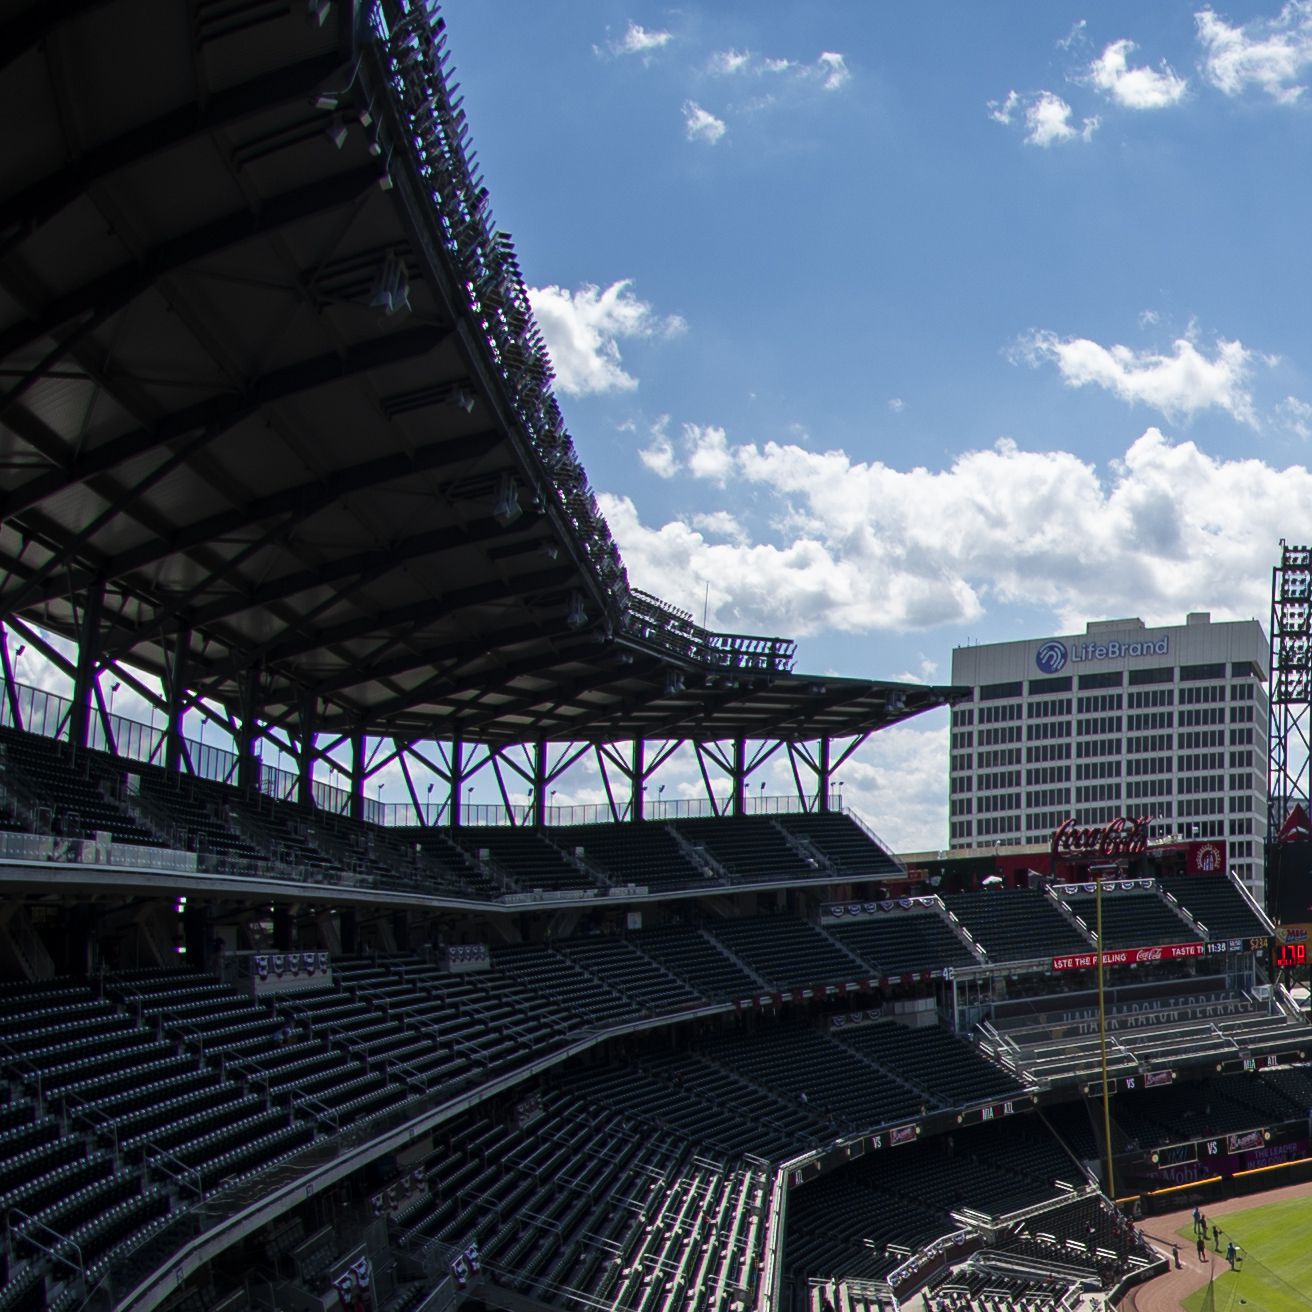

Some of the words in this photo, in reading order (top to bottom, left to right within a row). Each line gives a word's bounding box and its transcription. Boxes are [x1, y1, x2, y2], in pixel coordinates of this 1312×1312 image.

[1071, 635, 1169, 662] LifeBrand
[1075, 954, 1091, 966] THE
[1093, 952, 1127, 964] FELING
[1136, 949, 1163, 961] Coca-Cola
[1172, 947, 1195, 956] TASTE
[1281, 945, 1305, 959] 170
[943, 967, 954, 980] 42
[1243, 1060, 1256, 1070] MIA
[1267, 1056, 1279, 1066] ATL
[1126, 1078, 1136, 1089] VS
[872, 1136, 882, 1149] VS
[1207, 1142, 1218, 1155] VS
